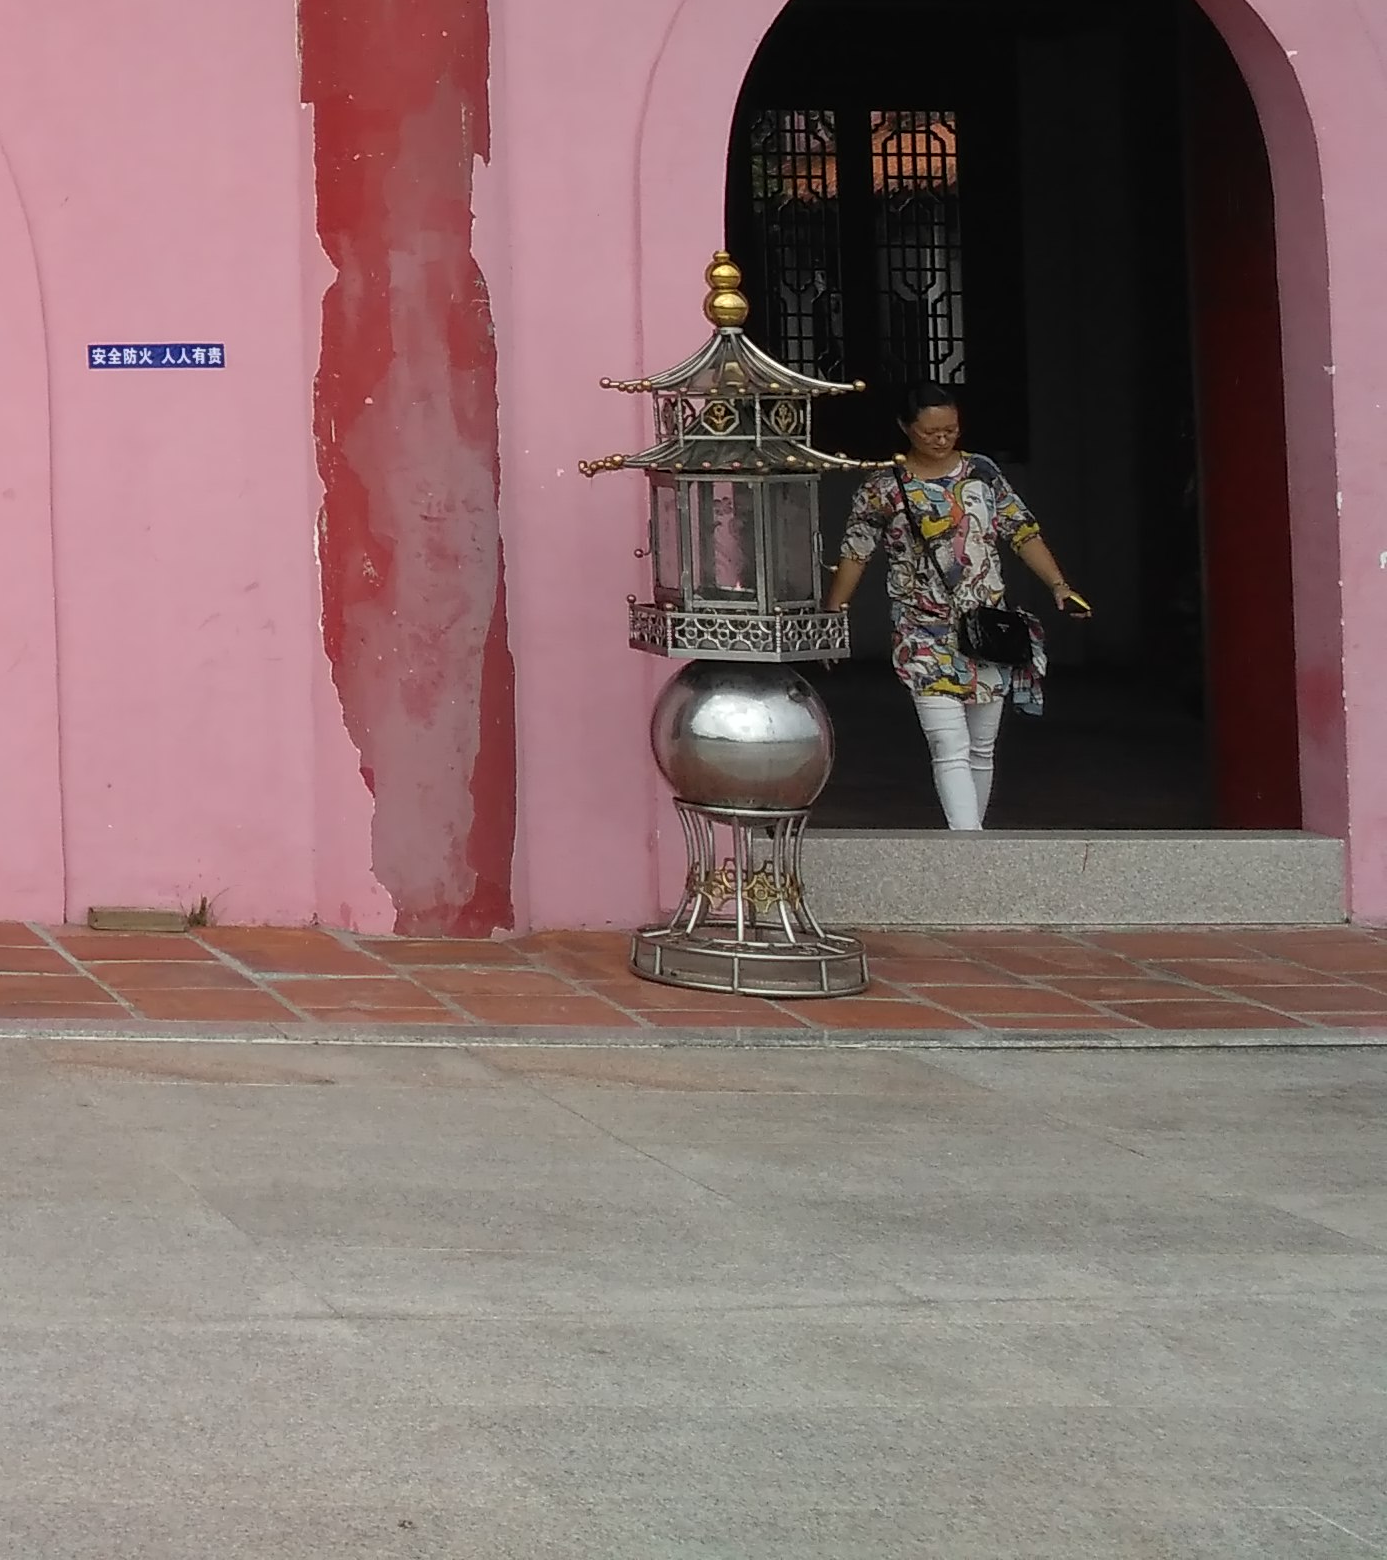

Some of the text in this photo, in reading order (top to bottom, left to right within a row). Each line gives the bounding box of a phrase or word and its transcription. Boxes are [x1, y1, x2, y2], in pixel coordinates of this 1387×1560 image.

[92, 347, 222, 364] 安全防火 人人有责
